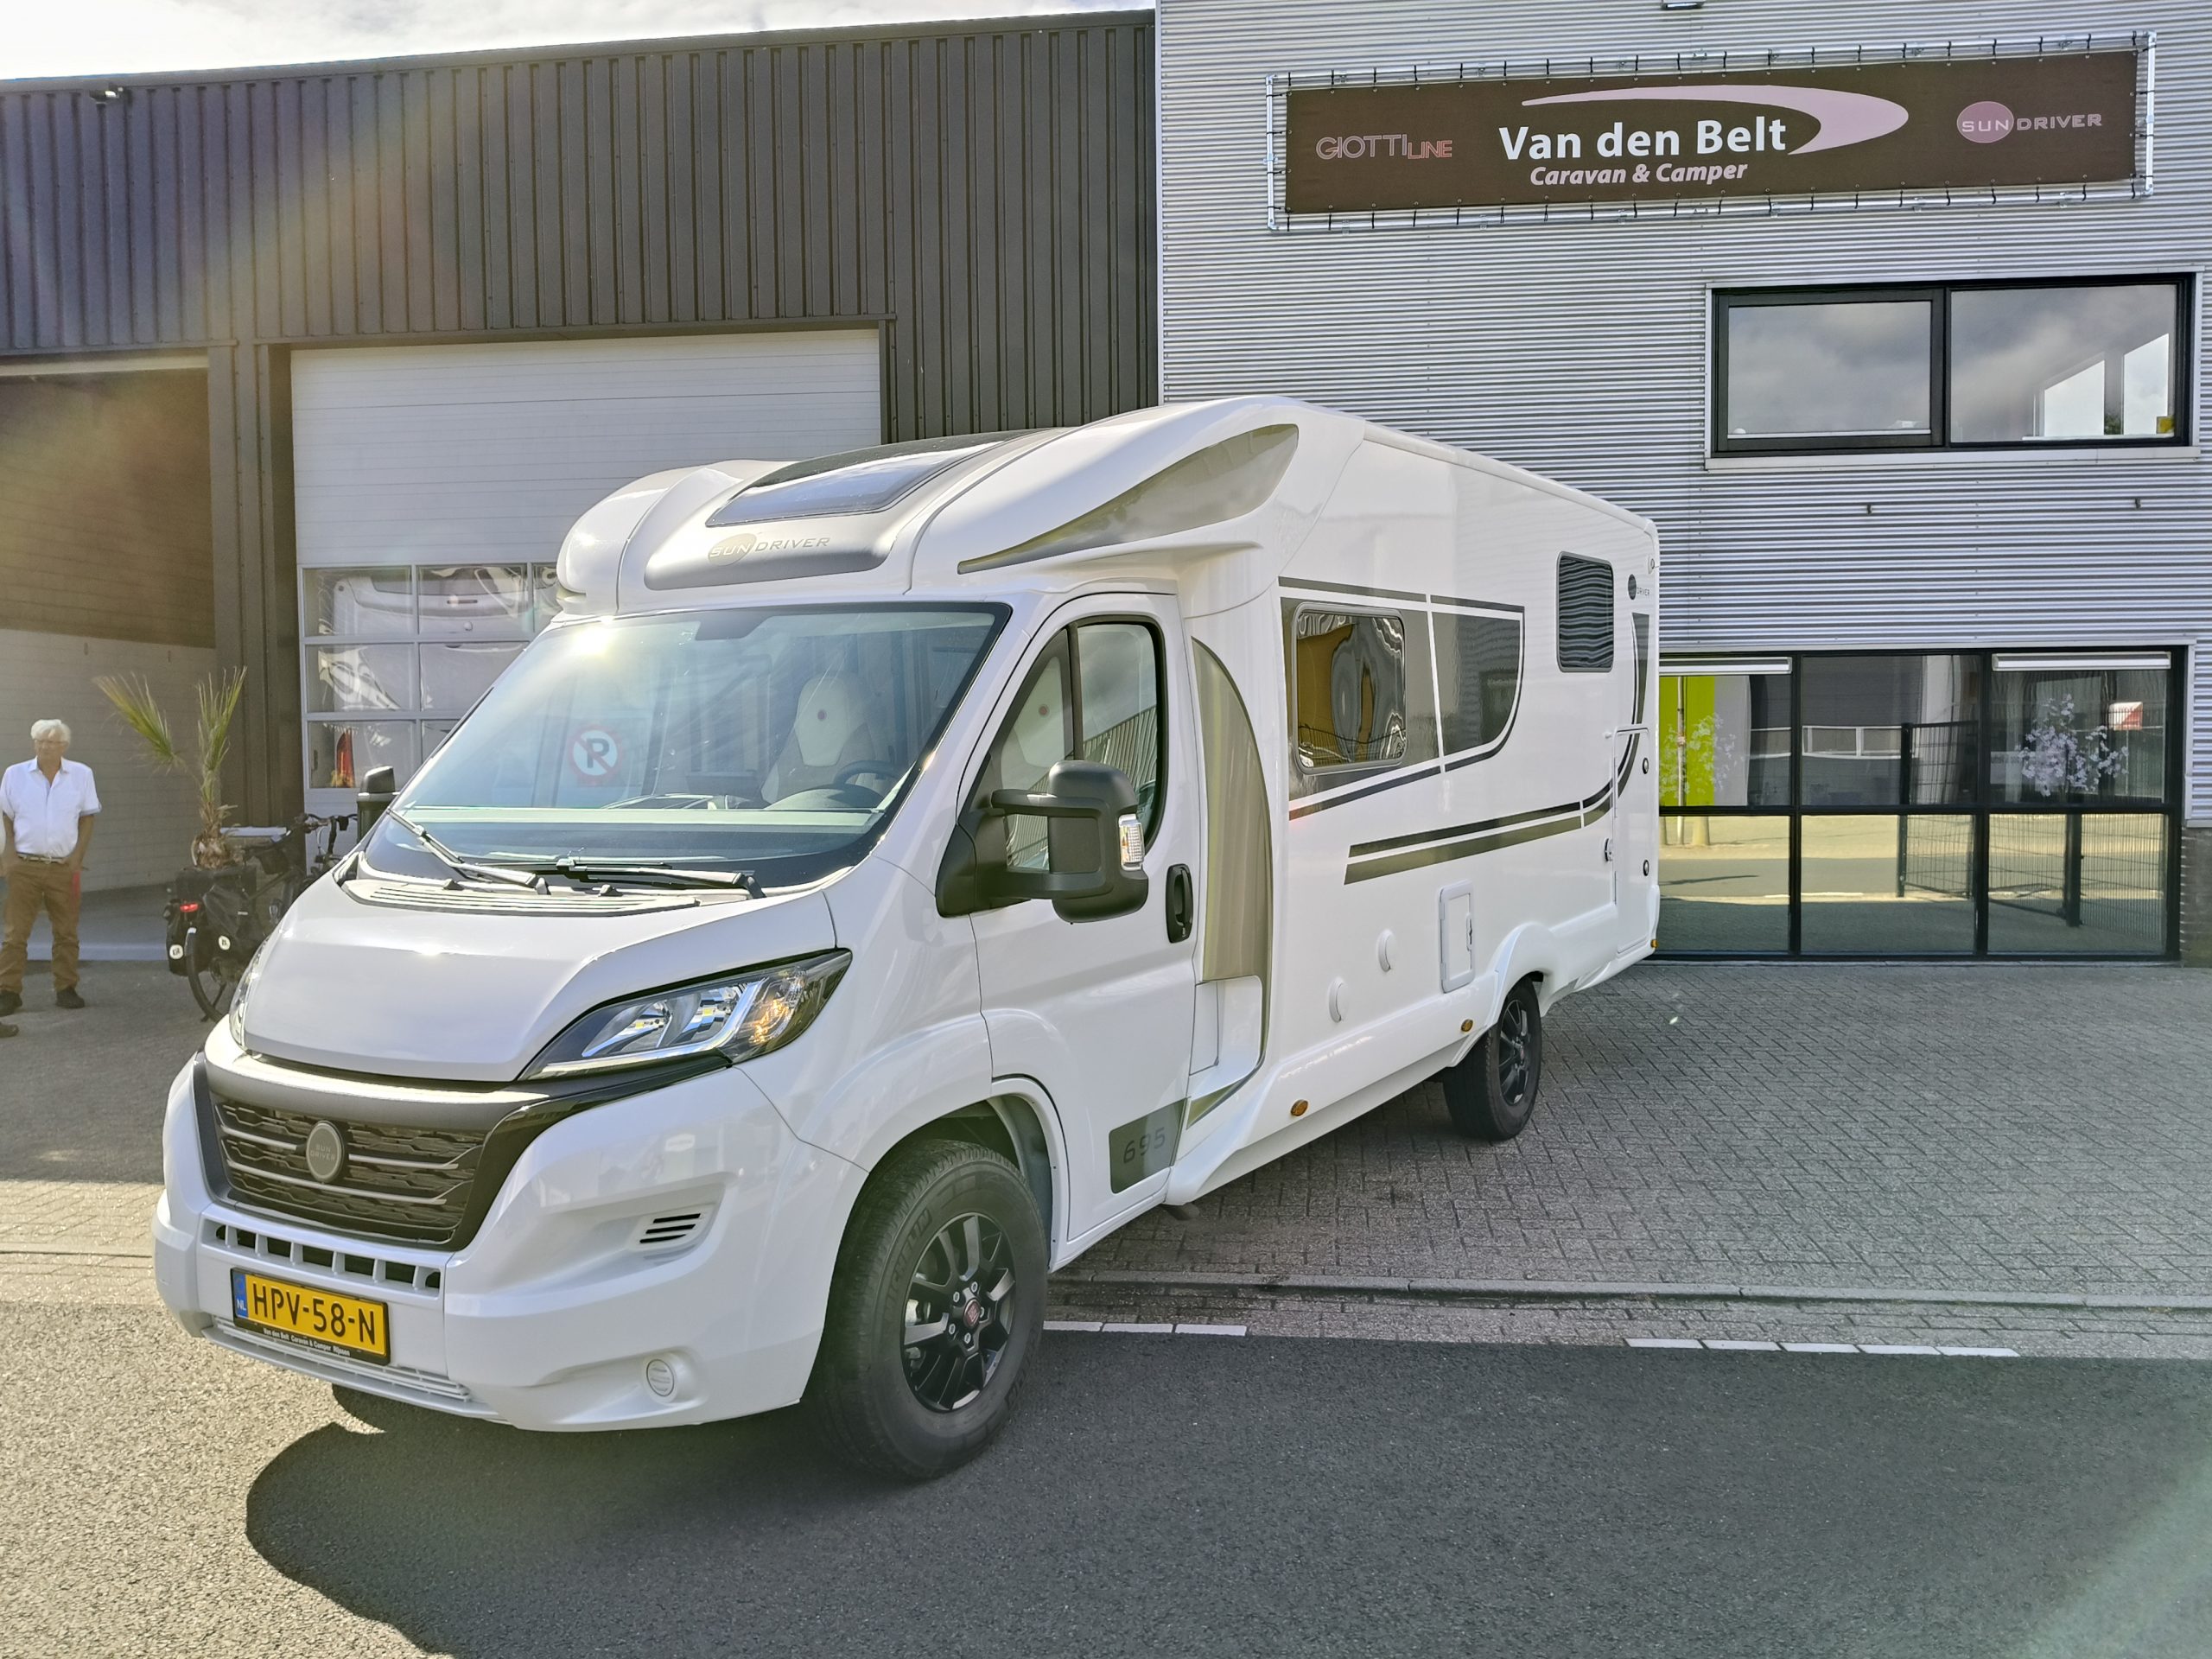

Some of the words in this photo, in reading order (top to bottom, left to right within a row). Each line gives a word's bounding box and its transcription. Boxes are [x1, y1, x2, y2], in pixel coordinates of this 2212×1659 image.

[1498, 126, 1581, 160] Van
[1596, 121, 1680, 157] den
[1696, 115, 1786, 155] Belt
[1529, 166, 1626, 186] Caravan
[1631, 163, 1649, 183] &
[1656, 162, 1749, 185] Camper
[1123, 1126, 1166, 1165] 695
[236, 1299, 246, 1311] NL
[253, 1283, 375, 1345] HPV-58-N
[263, 1327, 271, 1336] Van
[281, 1332, 289, 1340] Belt
[290, 1335, 308, 1345] Caravan
[314, 1341, 332, 1351] Camper
